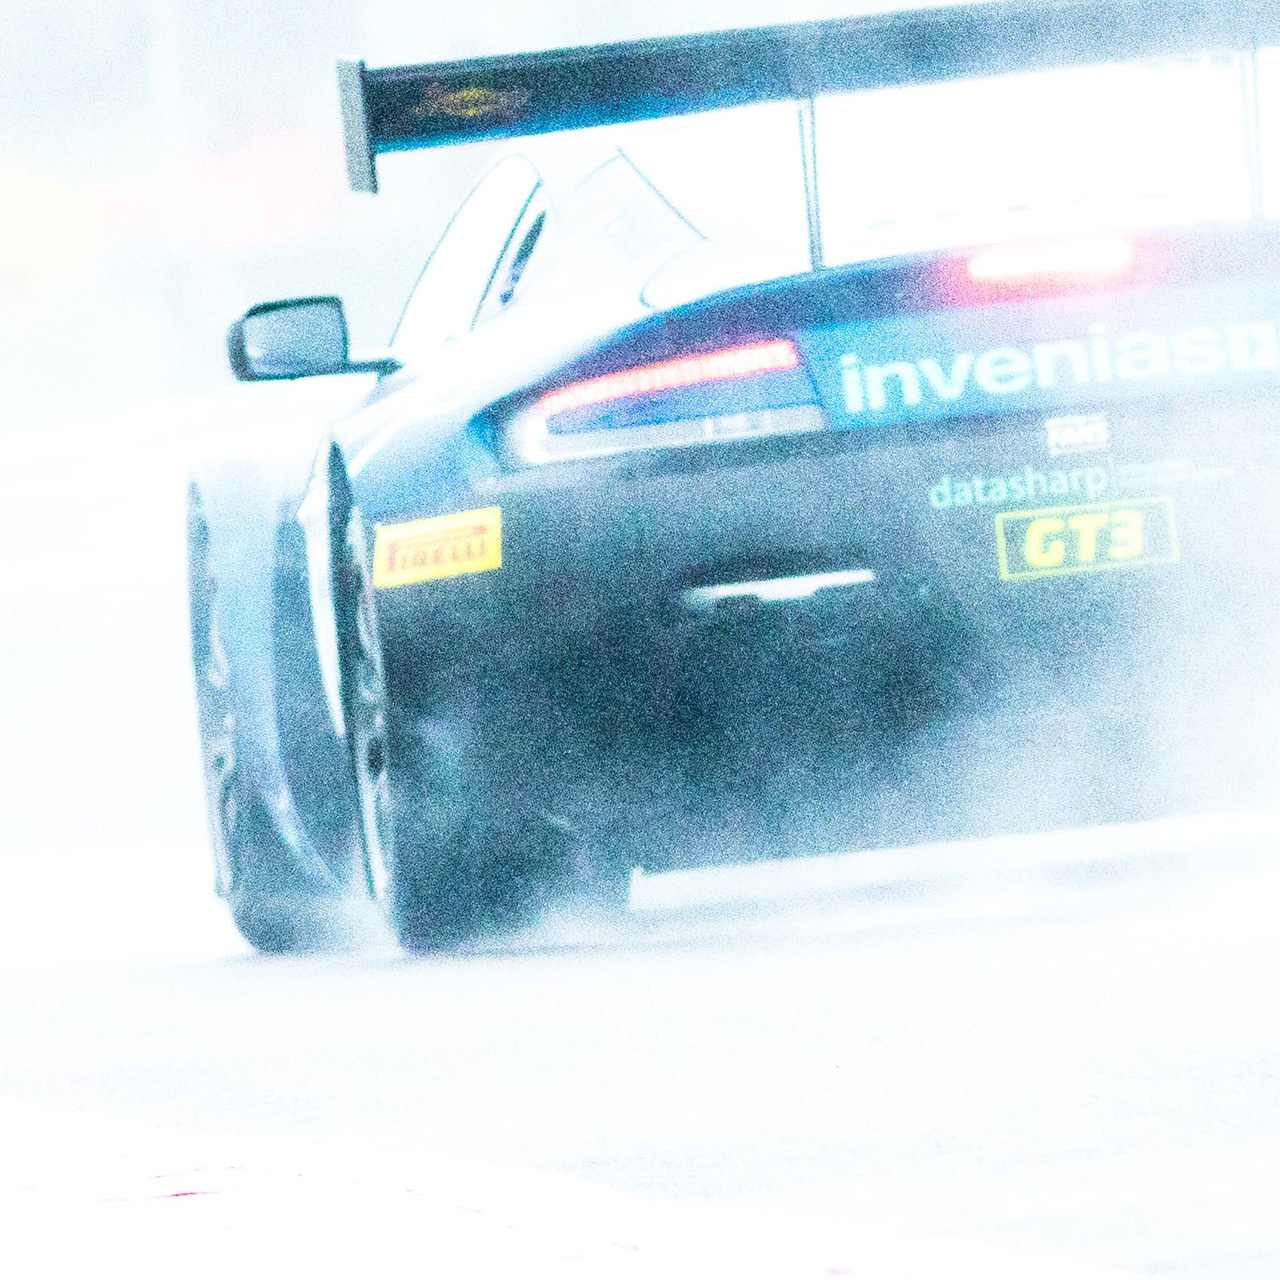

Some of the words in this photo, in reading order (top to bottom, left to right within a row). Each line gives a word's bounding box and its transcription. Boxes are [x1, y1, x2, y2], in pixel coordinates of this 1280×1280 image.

[928, 465, 1107, 511] datasharp
[385, 523, 487, 574] PIRELLI
[1025, 510, 1146, 568] GT3
